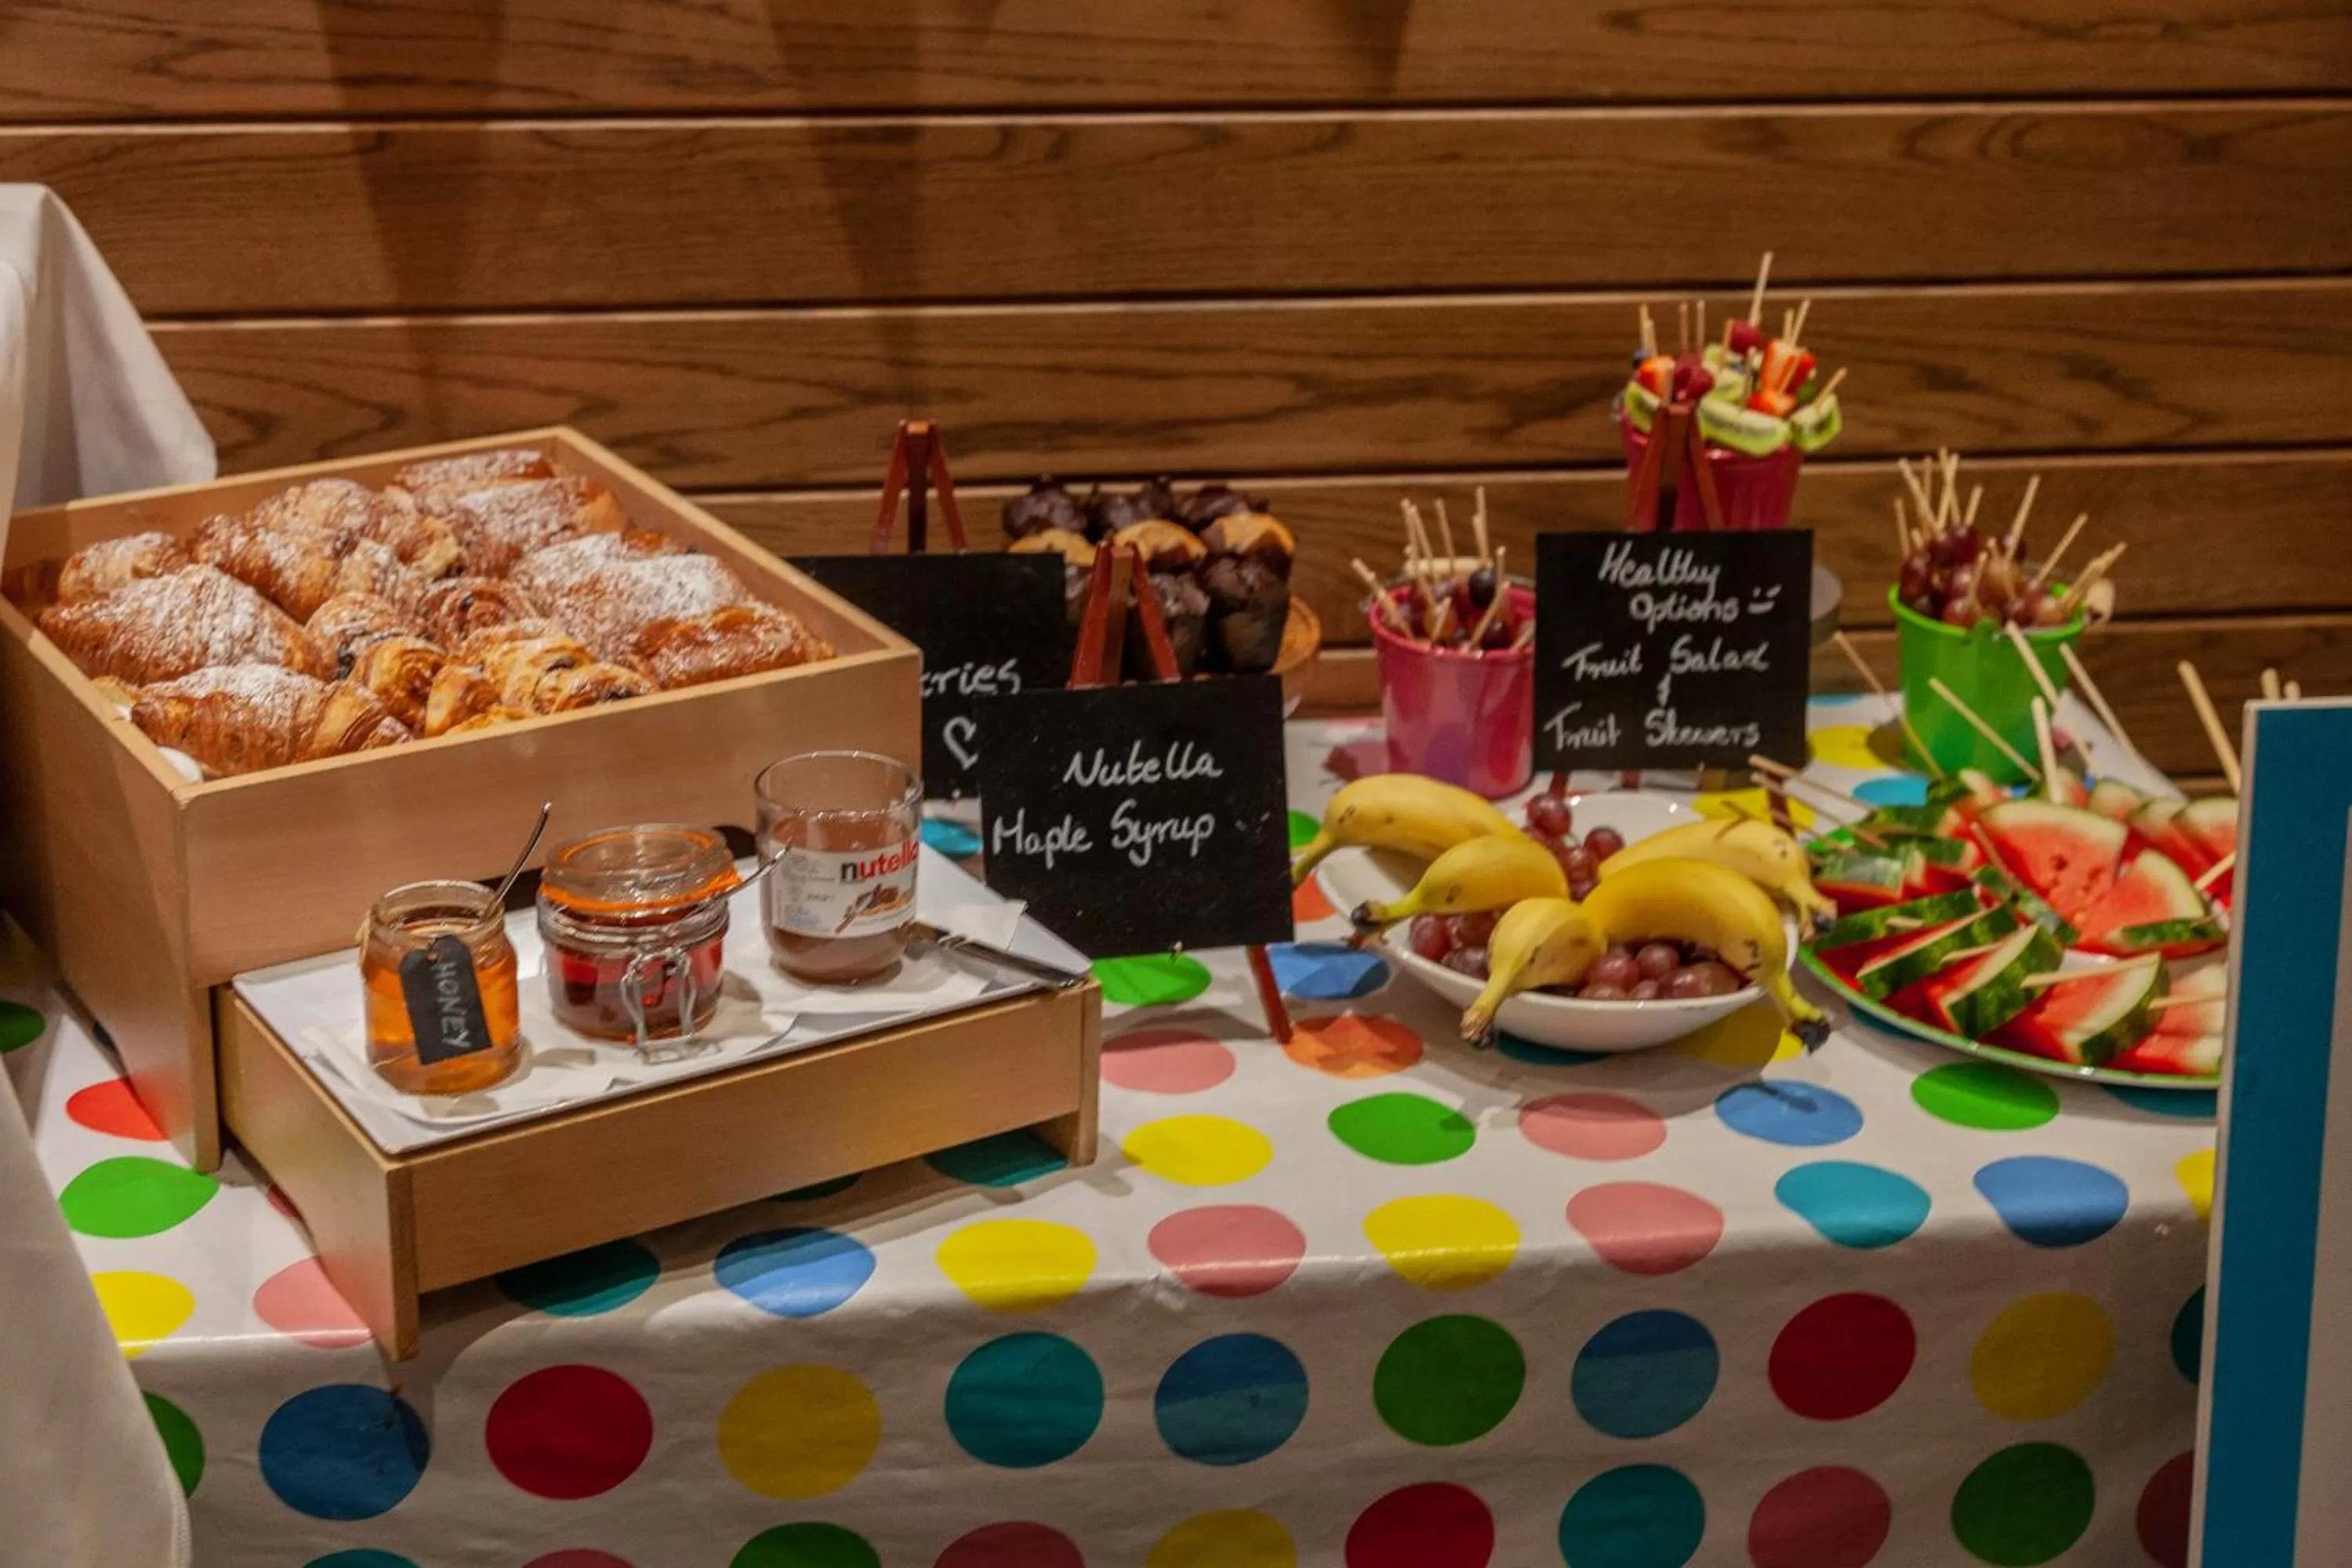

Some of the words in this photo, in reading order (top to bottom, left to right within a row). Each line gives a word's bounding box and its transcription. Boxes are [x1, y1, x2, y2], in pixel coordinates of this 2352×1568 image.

[1598, 539, 1721, 605] Healthy
[1629, 590, 1740, 634] Options
[1561, 641, 1643, 681] Fruit
[1669, 633, 1769, 674] Salad
[1543, 701, 1621, 753] Fruit
[1644, 706, 1761, 747] Skewers
[1062, 739, 1223, 788] Nutella
[992, 807, 1093, 870] Maple
[1110, 797, 1215, 867] Syrup
[431, 961, 472, 1049] HONEY
